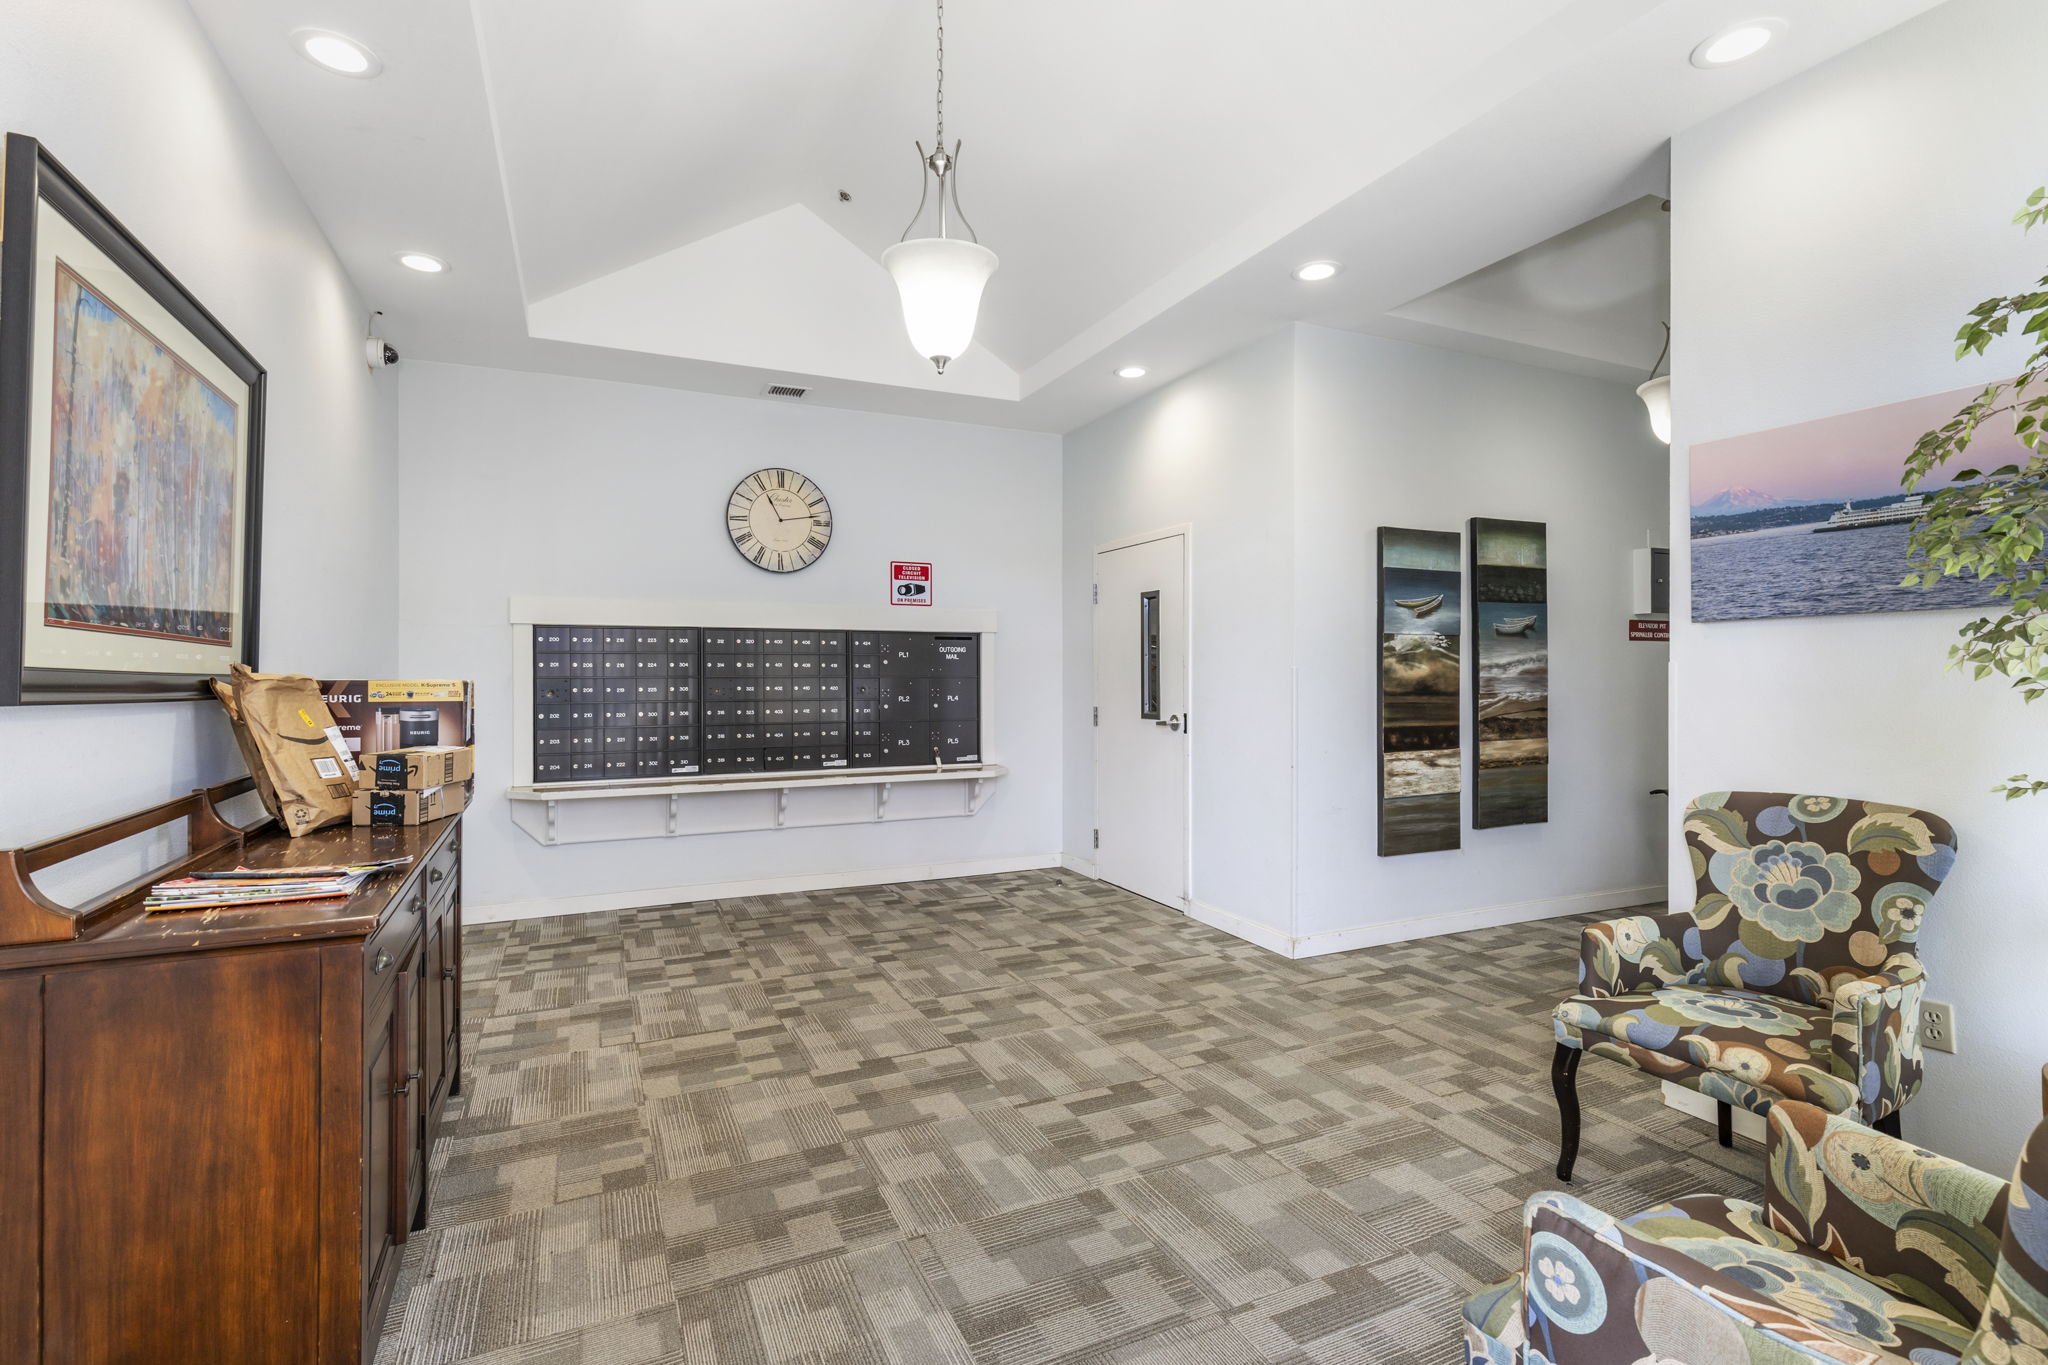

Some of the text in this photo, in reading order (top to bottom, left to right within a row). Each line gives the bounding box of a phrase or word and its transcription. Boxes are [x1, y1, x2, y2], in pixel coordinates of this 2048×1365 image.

[320, 694, 362, 703] EURIG
[947, 694, 959, 702] PL4
[378, 765, 401, 773] prime
[373, 808, 396, 817] prime
